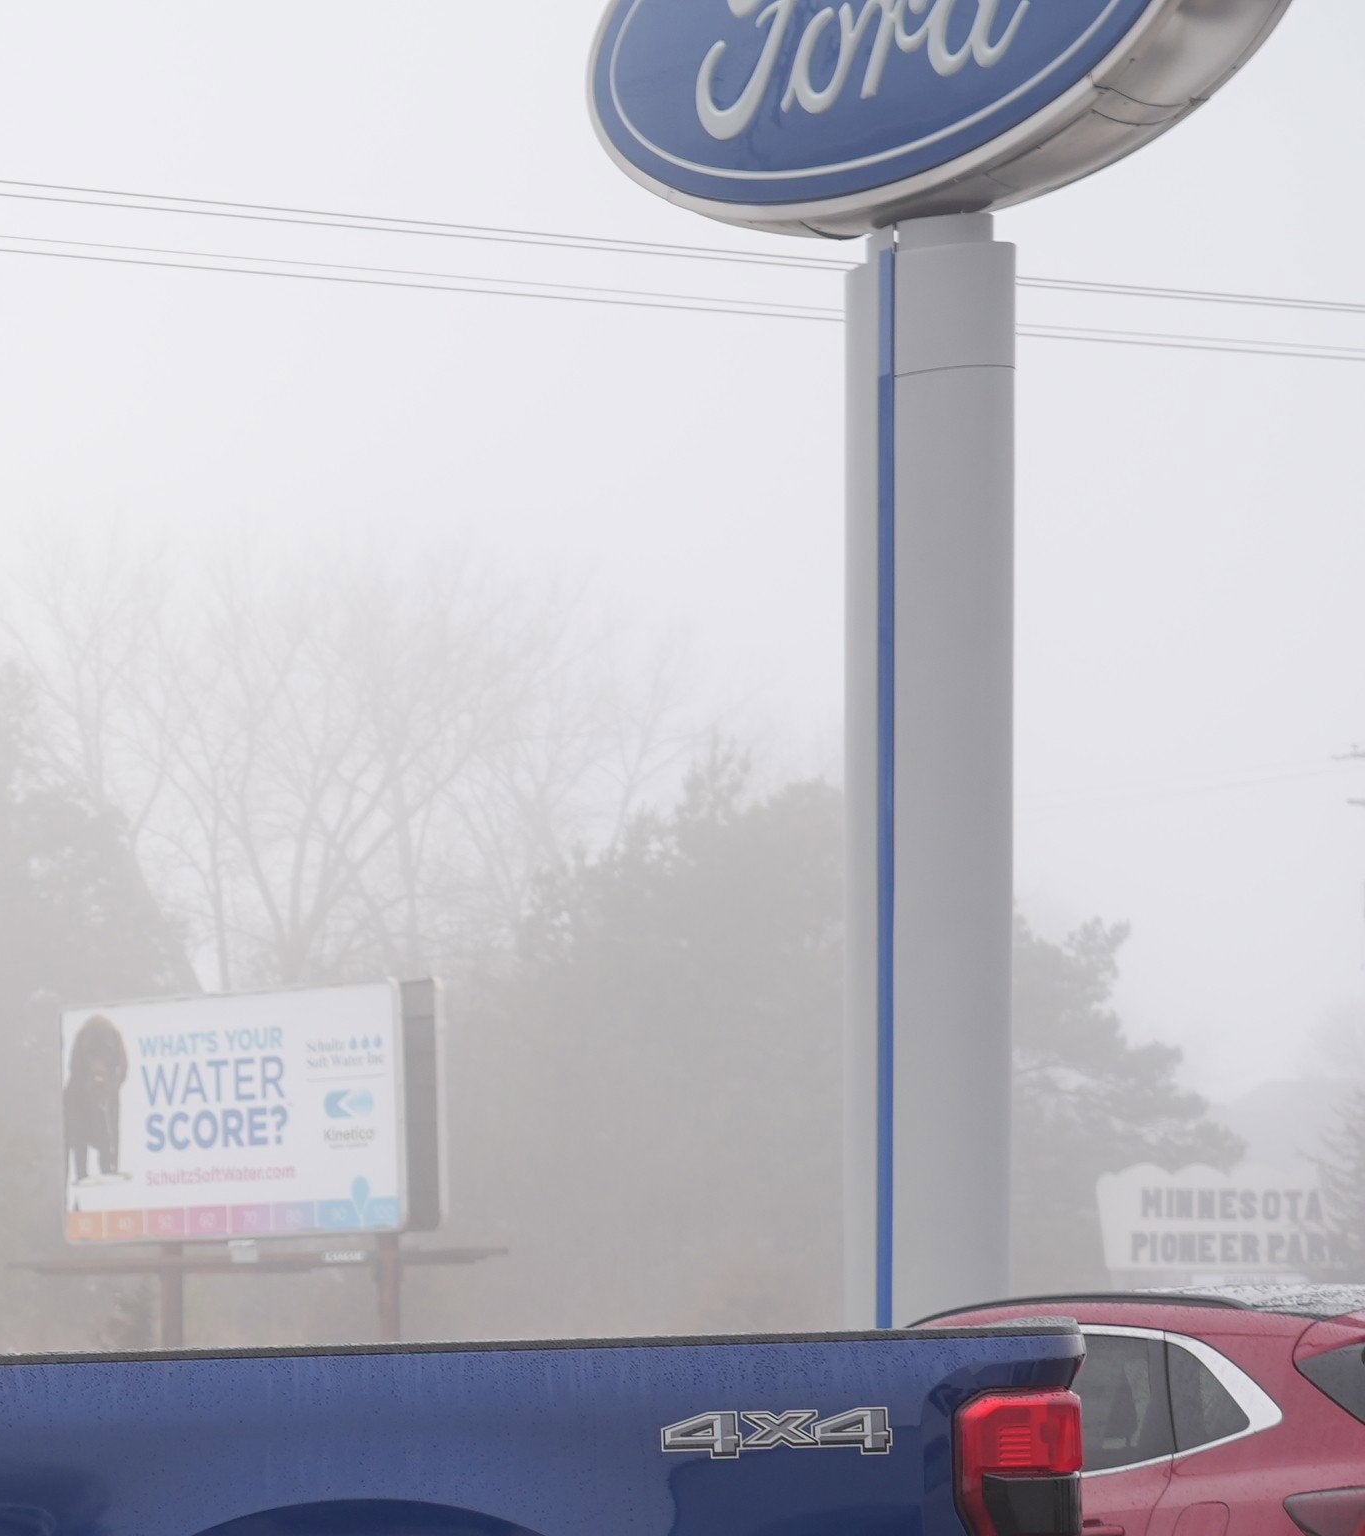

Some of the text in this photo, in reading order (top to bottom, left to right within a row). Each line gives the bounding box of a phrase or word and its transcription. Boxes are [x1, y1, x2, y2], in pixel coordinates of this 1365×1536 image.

[138, 1026, 283, 1057] WHAT'S YOUR
[141, 1055, 285, 1107] WATER
[145, 1105, 288, 1153] SCORE?
[323, 1126, 375, 1142] Kinetico
[1140, 1186, 1324, 1221] MINNESOTA
[1130, 1232, 1261, 1264] PIONEER
